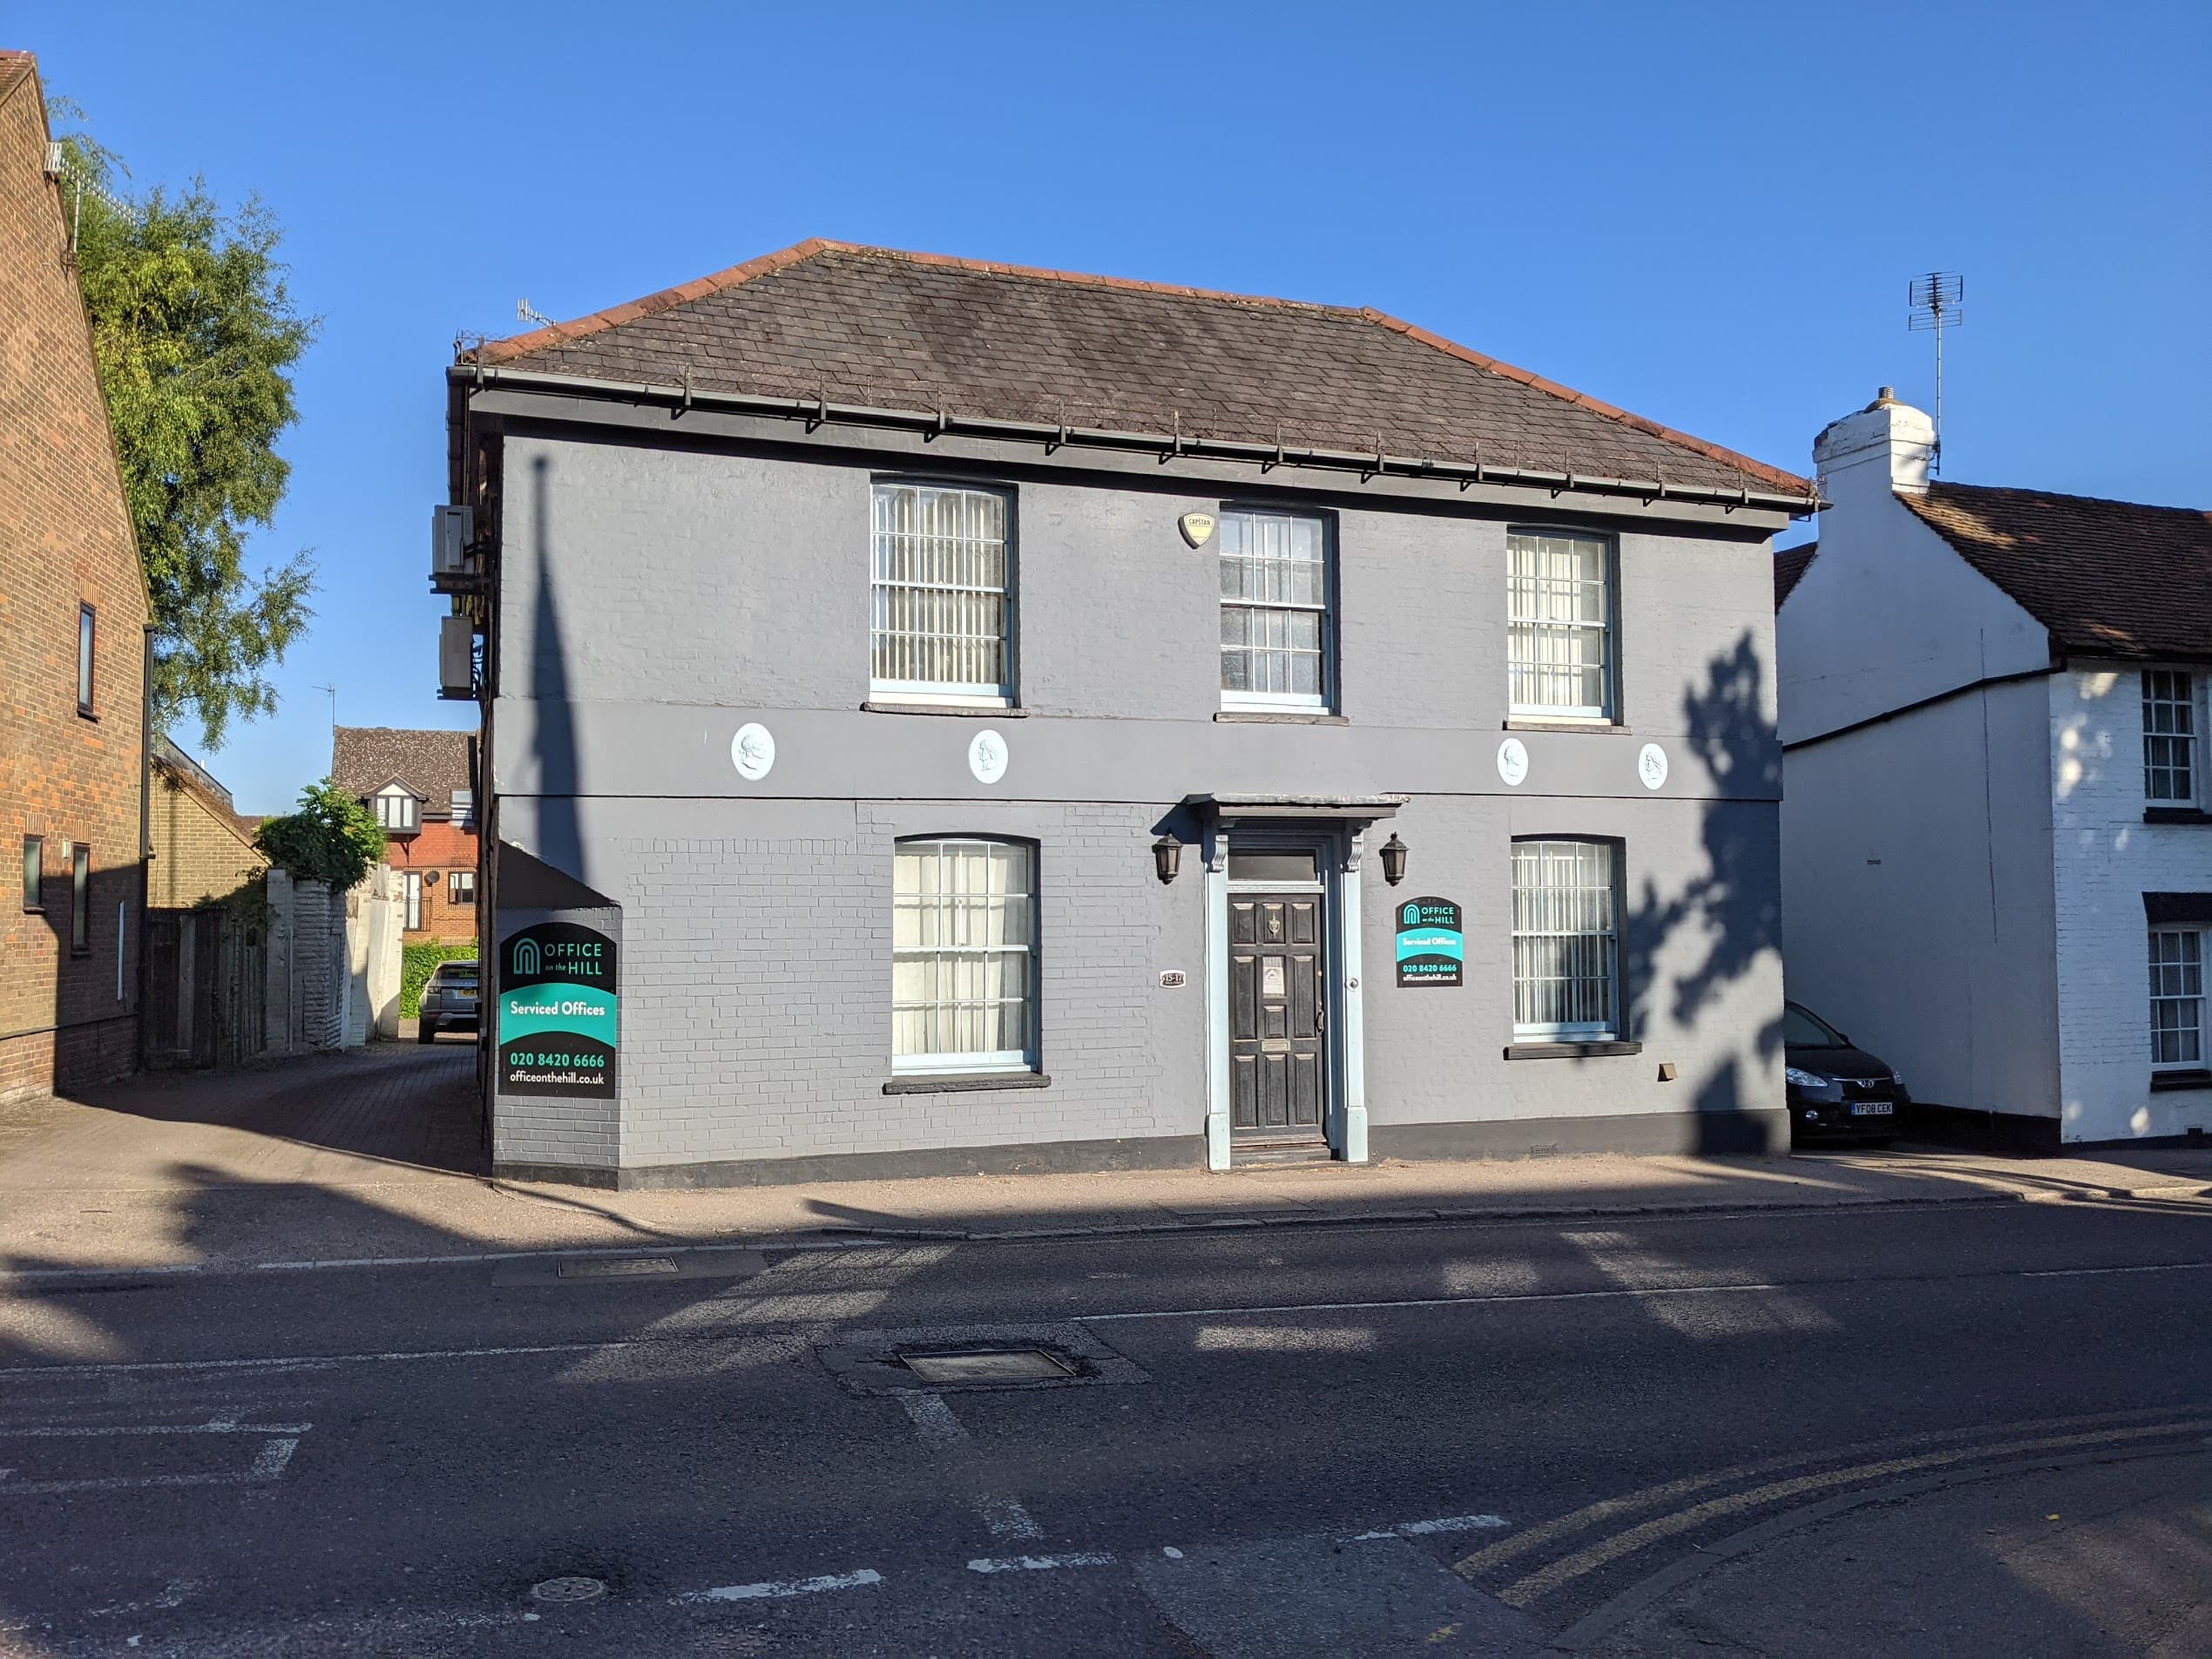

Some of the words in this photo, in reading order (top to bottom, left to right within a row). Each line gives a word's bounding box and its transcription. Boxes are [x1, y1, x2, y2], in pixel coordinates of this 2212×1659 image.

[1421, 906, 1454, 915] OFFICE
[1431, 937, 1457, 945] Offices
[545, 943, 602, 957] OFFICE
[555, 962, 566, 971] the
[568, 961, 603, 975] HILL
[511, 1001, 558, 1015] Serviced
[561, 1001, 605, 1016] Offices
[510, 1052, 534, 1066] 020
[538, 1053, 570, 1066] 8420
[573, 1053, 605, 1067] 6666
[510, 1070, 605, 1085] officeonthehill.co.uk
[1856, 1103, 1876, 1114] YF08
